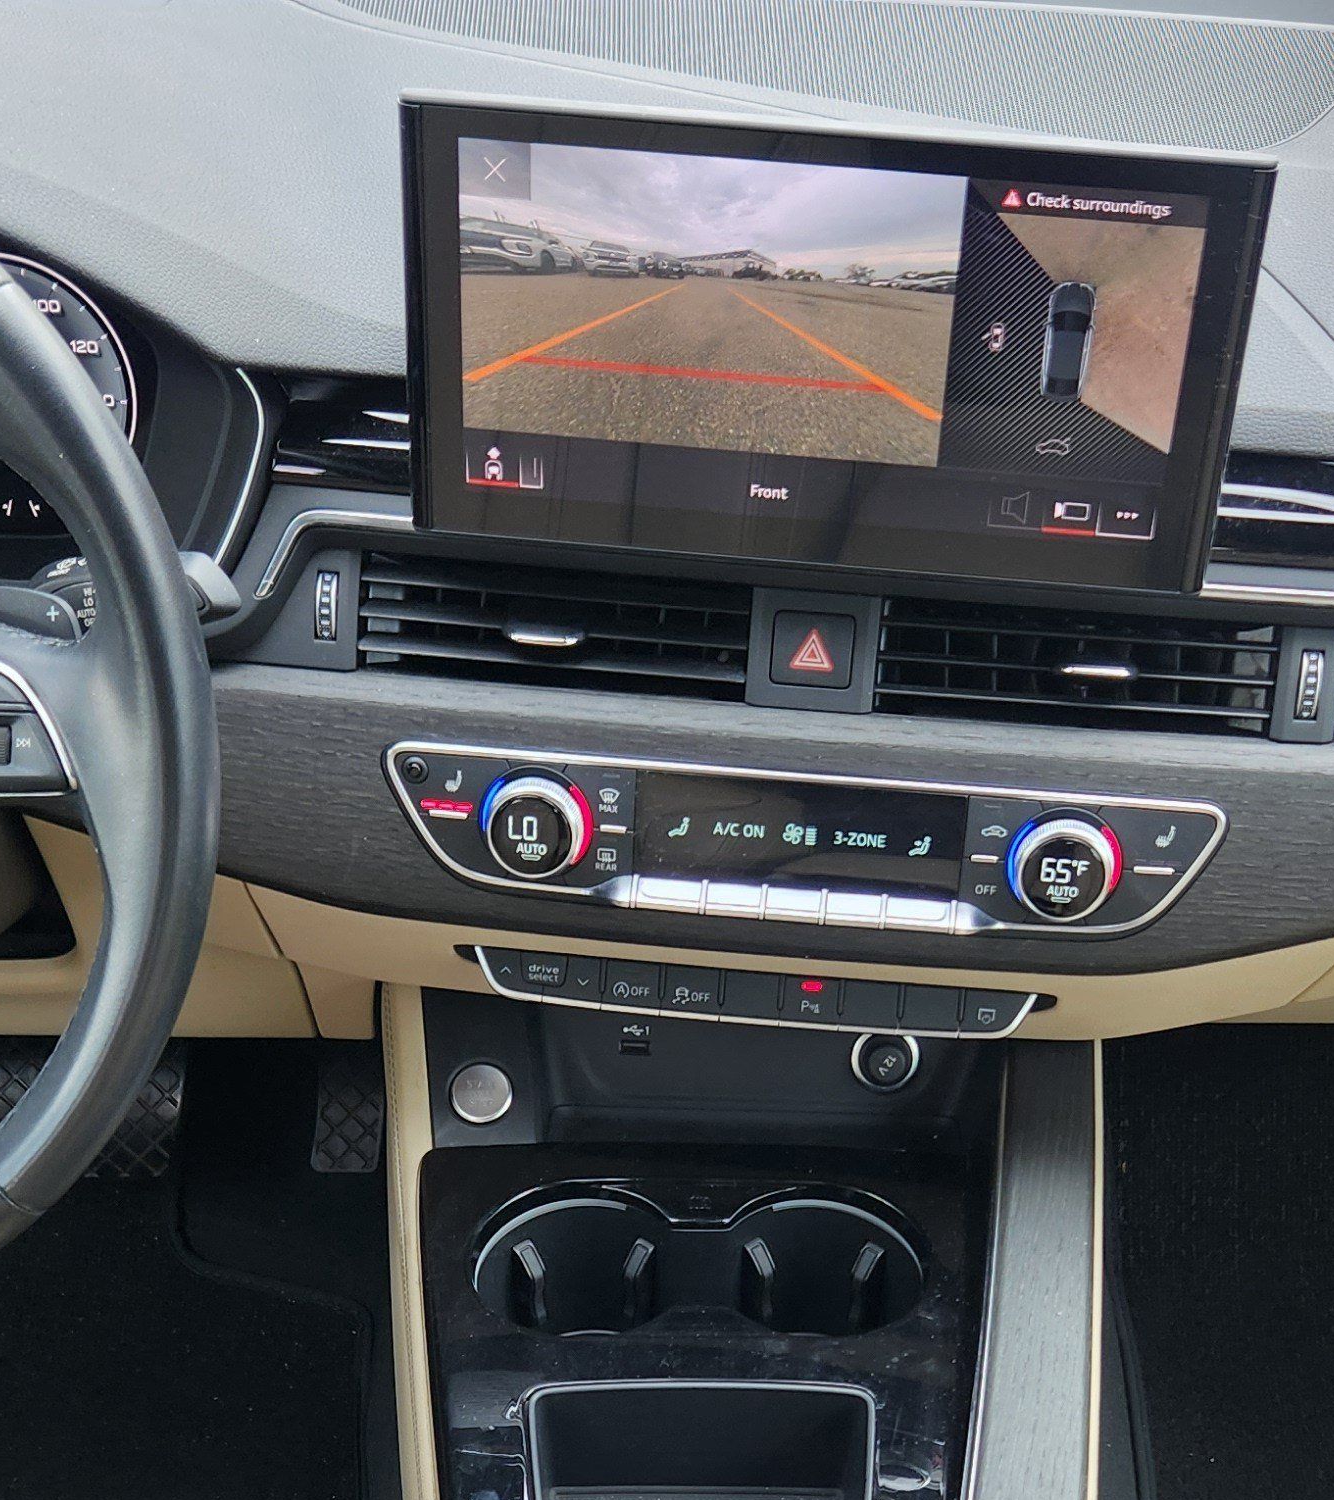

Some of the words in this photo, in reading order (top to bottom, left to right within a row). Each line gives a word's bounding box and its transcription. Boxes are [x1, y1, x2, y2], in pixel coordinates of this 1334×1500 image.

[1026, 191, 1072, 209] Check
[1072, 198, 1173, 219] surroundings
[69, 340, 100, 356] 120
[750, 483, 790, 500] Front
[83, 597, 94, 607] LO
[77, 607, 96, 618] AUTO
[598, 804, 618, 814] MAX
[507, 815, 538, 841] LO
[712, 821, 739, 837] A/C
[743, 823, 765, 839] ON
[833, 830, 888, 848] 3-ZONE
[516, 843, 548, 855] AUTO
[595, 862, 618, 872] REAR
[975, 884, 998, 896] OFF
[1045, 885, 1080, 898] AUTO
[528, 964, 560, 976] drive
[528, 972, 560, 983] select
[631, 986, 650, 997] OFF
[691, 992, 711, 1003] OFF
